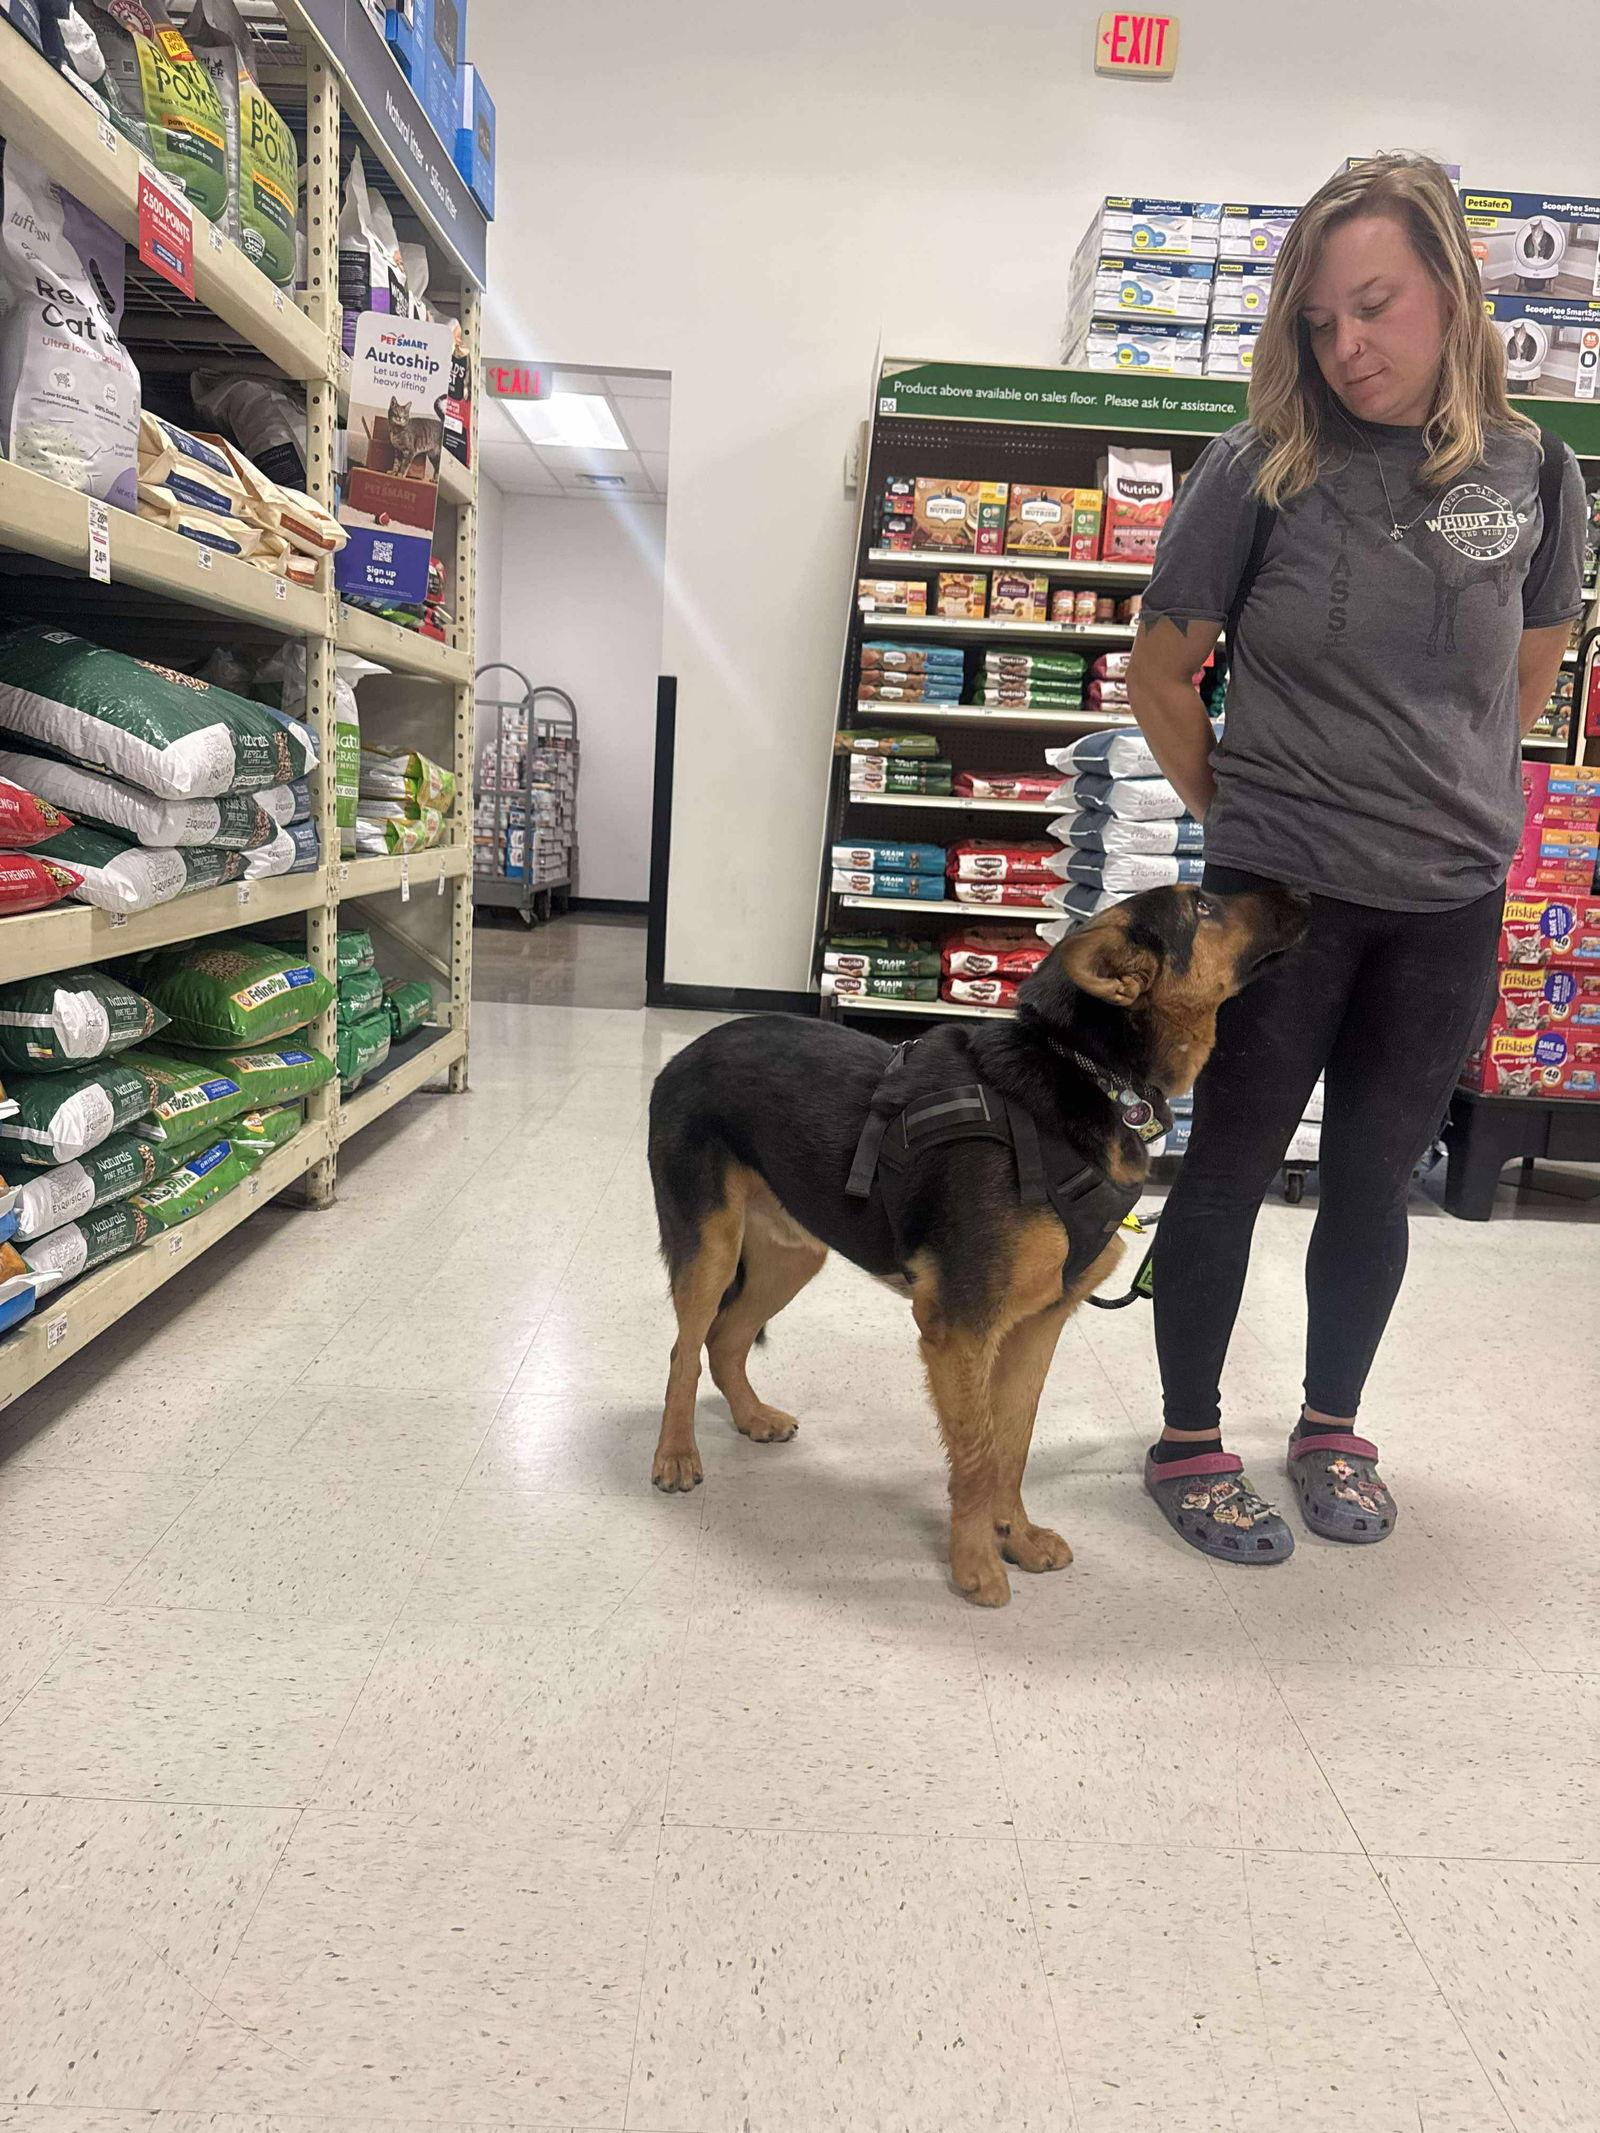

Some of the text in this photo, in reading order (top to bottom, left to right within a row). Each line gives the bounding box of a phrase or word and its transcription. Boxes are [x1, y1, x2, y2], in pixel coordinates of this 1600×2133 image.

[1111, 15, 1170, 66] EXIT
[385, 89, 458, 221] Natural litter Silica litter
[1468, 198, 1501, 209] PetSafe
[1542, 202, 1583, 213] ScoopFree
[165, 207, 191, 243] POINTS
[1525, 304, 1566, 316] ScoopFree
[42, 302, 97, 341] Cat
[42, 337, 70, 350] Ultra
[380, 333, 429, 351] PETSMART
[365, 346, 440, 375] Autoship
[373, 366, 428, 383] Let us do the
[373, 376, 426, 395] heavy lifting
[894, 380, 1237, 414] Product above available on sales floor. Please ask for assistance.
[881, 400, 895, 412] P6
[1119, 481, 1160, 495] Nutrish
[1442, 492, 1460, 512] OPEN
[1475, 487, 1492, 499] CAN
[1496, 497, 1509, 507] OF
[929, 506, 962, 516] NUTRISH
[1025, 509, 1058, 518] NUTRISH
[1496, 512, 1529, 528] ASS
[1462, 544, 1481, 557] CAN
[1496, 533, 1515, 554] OPEN
[366, 565, 397, 579] Sign up
[366, 574, 395, 587] & save
[1130, 832, 1172, 841] EXQUISICAT
[880, 849, 905, 858] GRAIN
[0, 868, 37, 882] STRENGTH
[879, 875, 904, 883] GRAIN
[1130, 869, 1173, 877] EXQUISICAT
[1548, 918, 1558, 937] SAVE
[839, 960, 864, 968] Nutrish
[876, 958, 906, 966] GRAIN
[836, 981, 861, 989] Nutrish
[873, 979, 903, 988] GRAIN
[1503, 972, 1542, 987] Friskies
[877, 986, 898, 994] FREE
[107, 993, 137, 1007] Naturals
[1494, 1038, 1534, 1053] Friskies
[1538, 1040, 1556, 1051] SAVE
[113, 1079, 142, 1097] Naturals
[96, 1150, 133, 1173] Naturals
[200, 1150, 223, 1169] ORIGINAL
[103, 1163, 135, 1182] PINE PELLET
[52, 1189, 89, 1215] EXQUISICAT
[91, 1211, 127, 1235] Naturals
